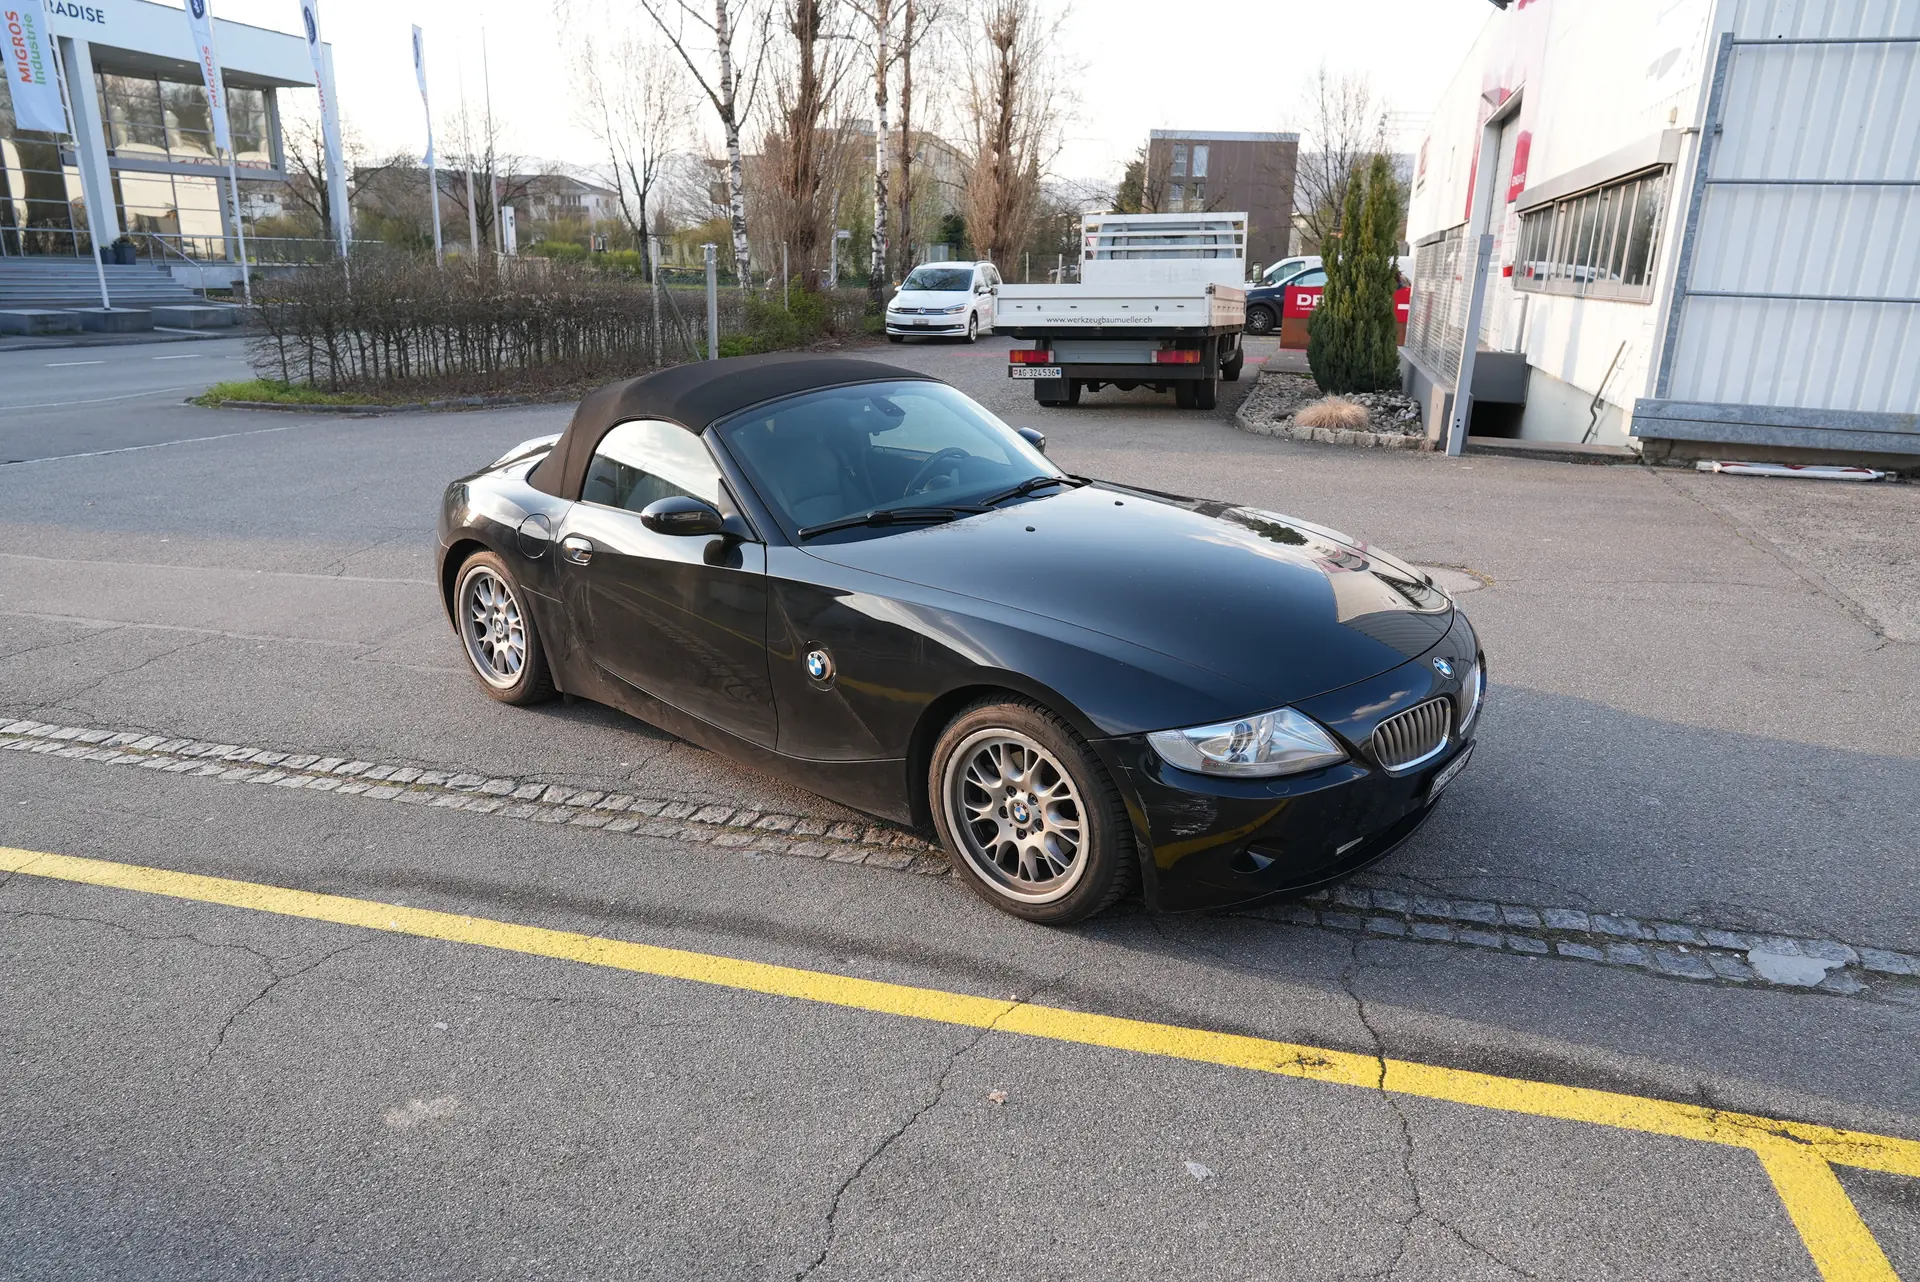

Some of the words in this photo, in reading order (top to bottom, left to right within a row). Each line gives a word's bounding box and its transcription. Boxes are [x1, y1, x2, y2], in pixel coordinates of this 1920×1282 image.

[5, 10, 32, 83] MIGROS
[23, 13, 46, 85] Industrie
[203, 45, 218, 108] MIGROS
[1046, 316, 1153, 325] www.werkzeugbaumueller.ch
